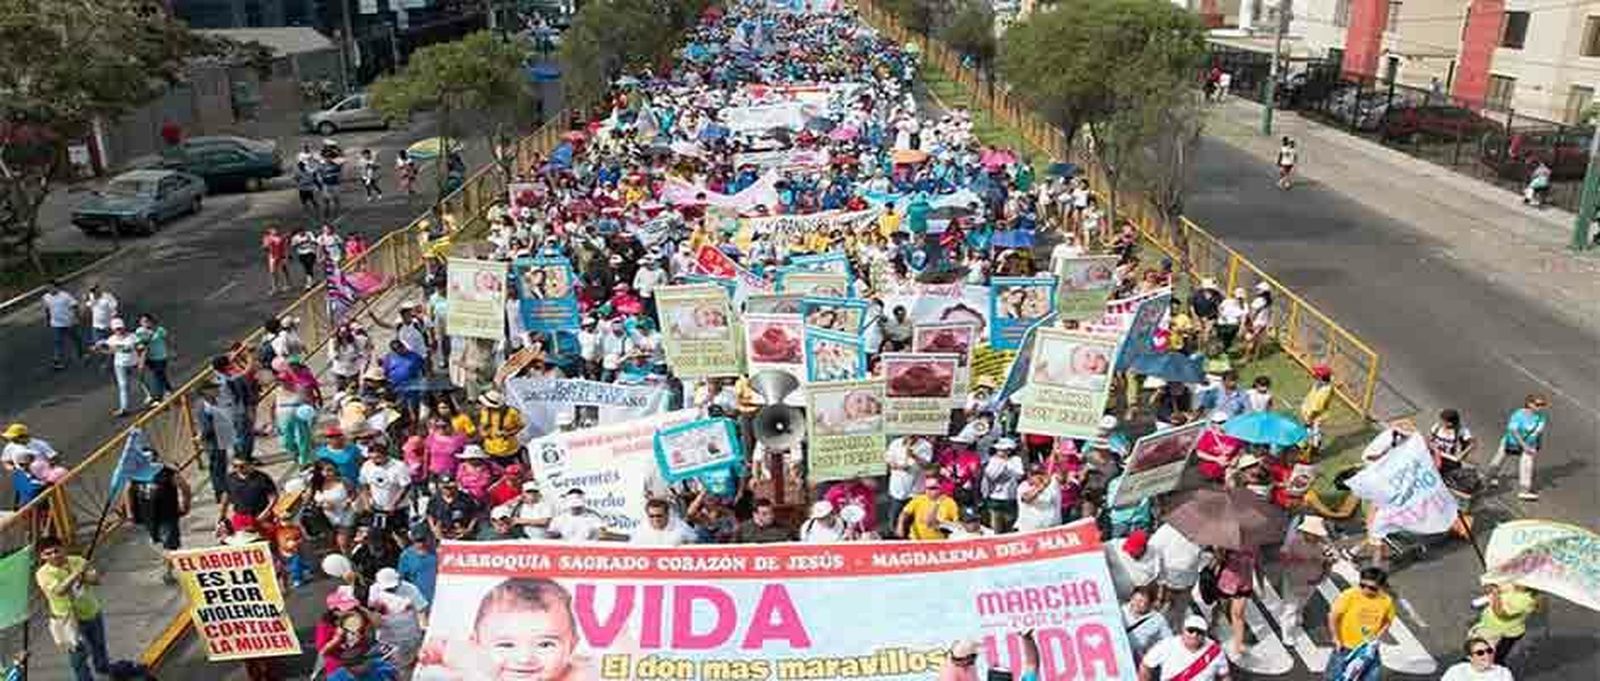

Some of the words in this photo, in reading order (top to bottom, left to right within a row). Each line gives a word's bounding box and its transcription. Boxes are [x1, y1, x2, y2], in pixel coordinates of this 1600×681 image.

[178, 557, 198, 572] EL
[200, 549, 266, 570] ABORTO
[440, 553, 550, 570] PARROQUIA
[557, 554, 650, 571] SAGRADO
[656, 553, 746, 571] CORAZÓN
[754, 555, 780, 571] DE
[785, 549, 845, 571] JESÚS
[870, 548, 989, 568] MAGDALENA
[994, 541, 1034, 556] DEL
[1037, 531, 1081, 551] MAR
[197, 571, 226, 588] ES
[229, 569, 258, 585] LA
[203, 586, 263, 605] PEOR
[976, 580, 1101, 616] MARCHA
[197, 603, 281, 623] VIOLENCIA
[575, 583, 811, 649] VIDA
[204, 620, 287, 639] CONTRA
[209, 639, 232, 654] LA
[235, 634, 294, 653] MUJER
[983, 623, 1118, 681] VDA
[601, 654, 629, 678] El
[636, 653, 694, 680] don
[702, 657, 770, 680] mas
[777, 648, 949, 680] maravillos
